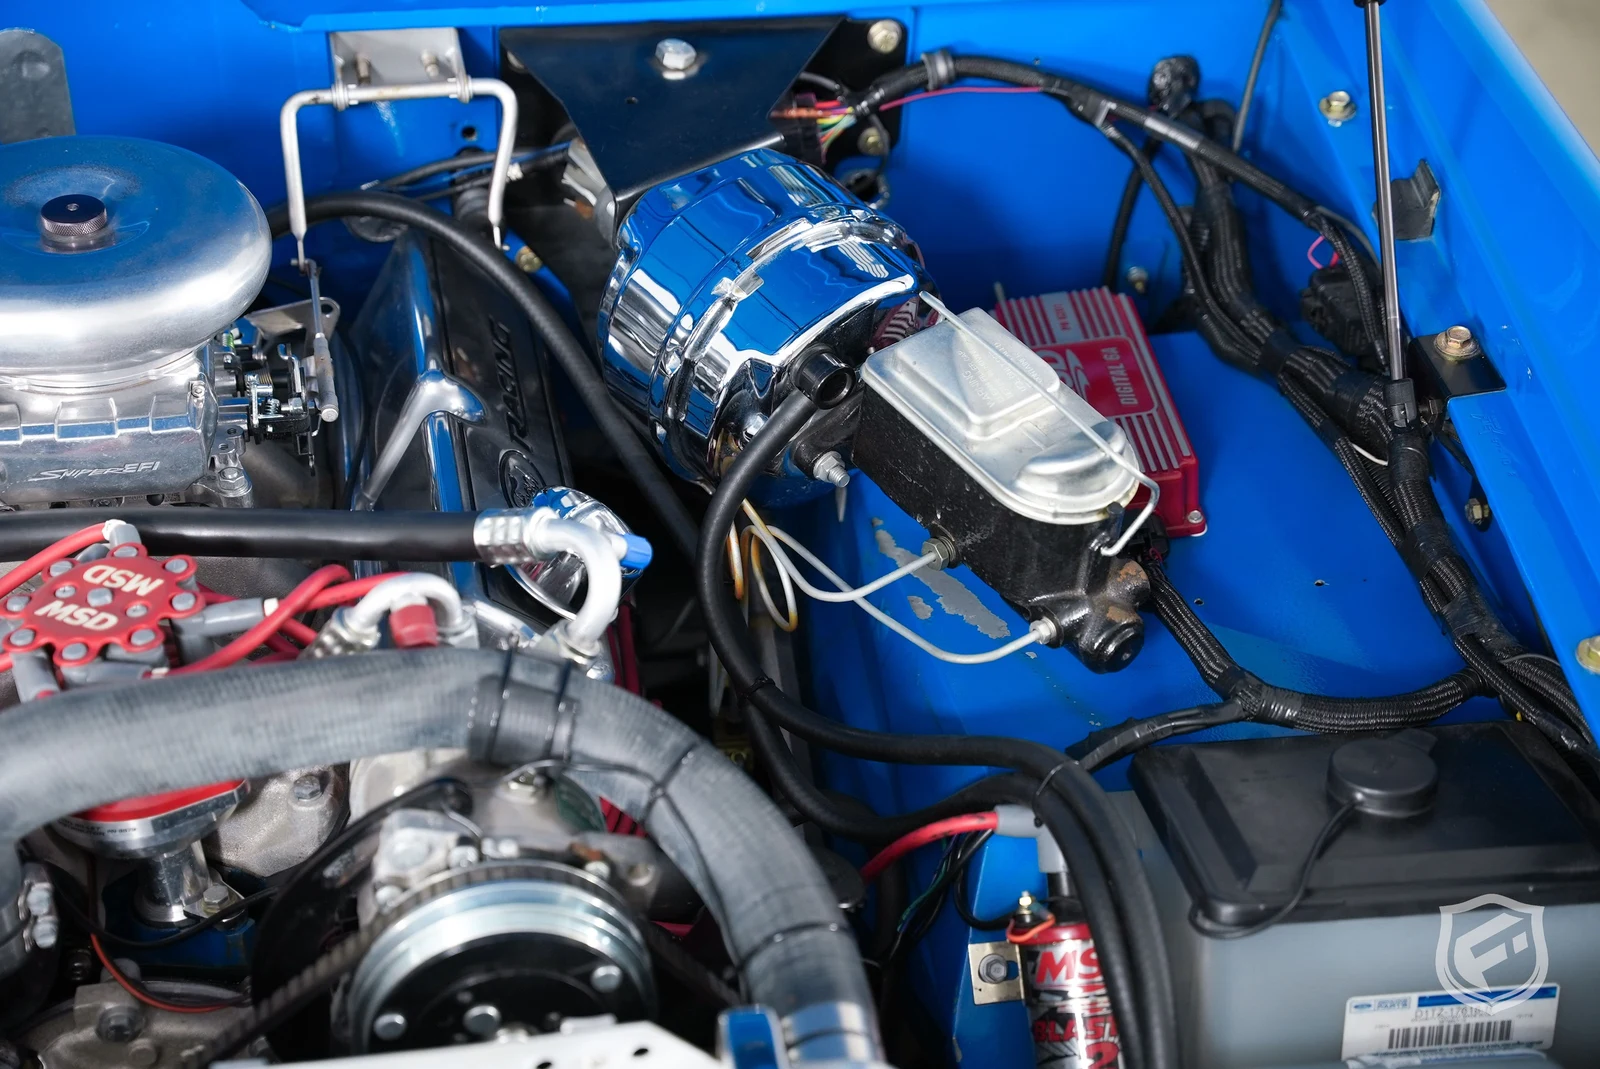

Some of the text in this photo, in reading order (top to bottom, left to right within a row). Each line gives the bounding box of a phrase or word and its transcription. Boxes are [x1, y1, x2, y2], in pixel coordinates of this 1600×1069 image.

[489, 314, 534, 452] RACING
[962, 368, 995, 407] WARNING
[1101, 346, 1139, 405] DIGITAL 6A
[83, 565, 164, 596] MSD
[34, 600, 118, 631] MSD
[1036, 947, 1102, 984] MS
[1034, 1015, 1118, 1043] BLAST
[1086, 1042, 1119, 1069] 2
